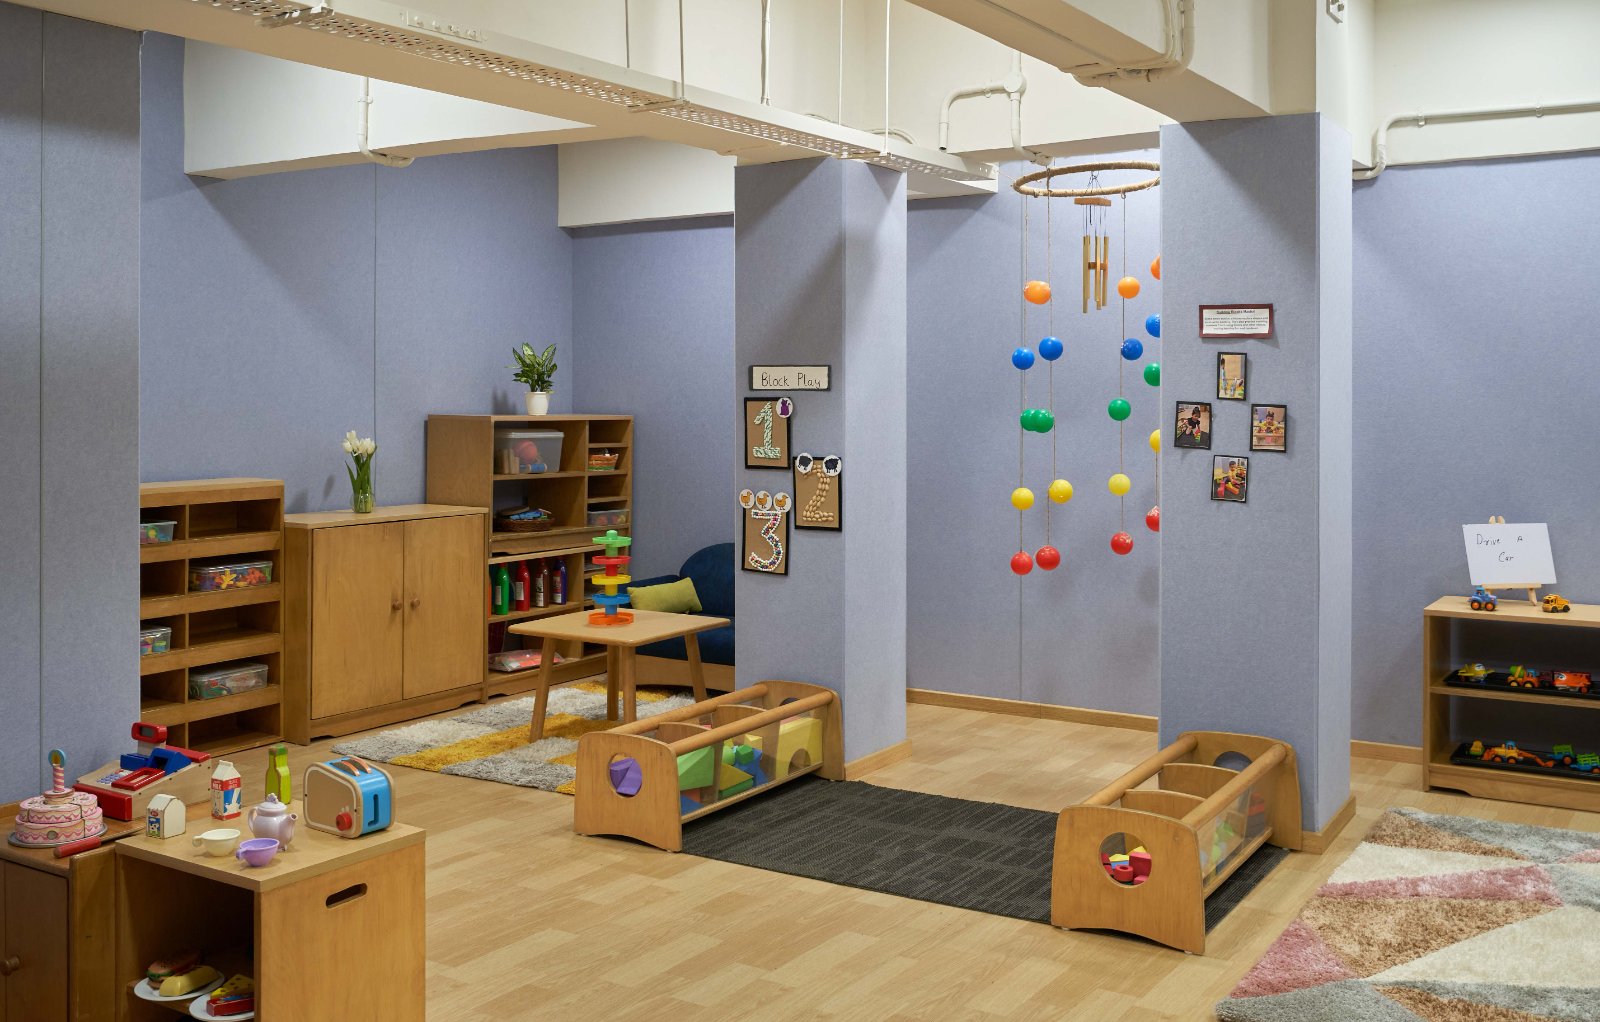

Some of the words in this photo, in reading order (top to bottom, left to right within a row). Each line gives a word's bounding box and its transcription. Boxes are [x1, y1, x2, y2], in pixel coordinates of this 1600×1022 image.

[761, 372, 790, 387] Block
[797, 372, 821, 390] Play
[753, 401, 781, 458] 1
[803, 464, 834, 521] 2
[749, 508, 783, 572] 3
[1476, 534, 1500, 546] Drive
[1498, 552, 1514, 562] Car
